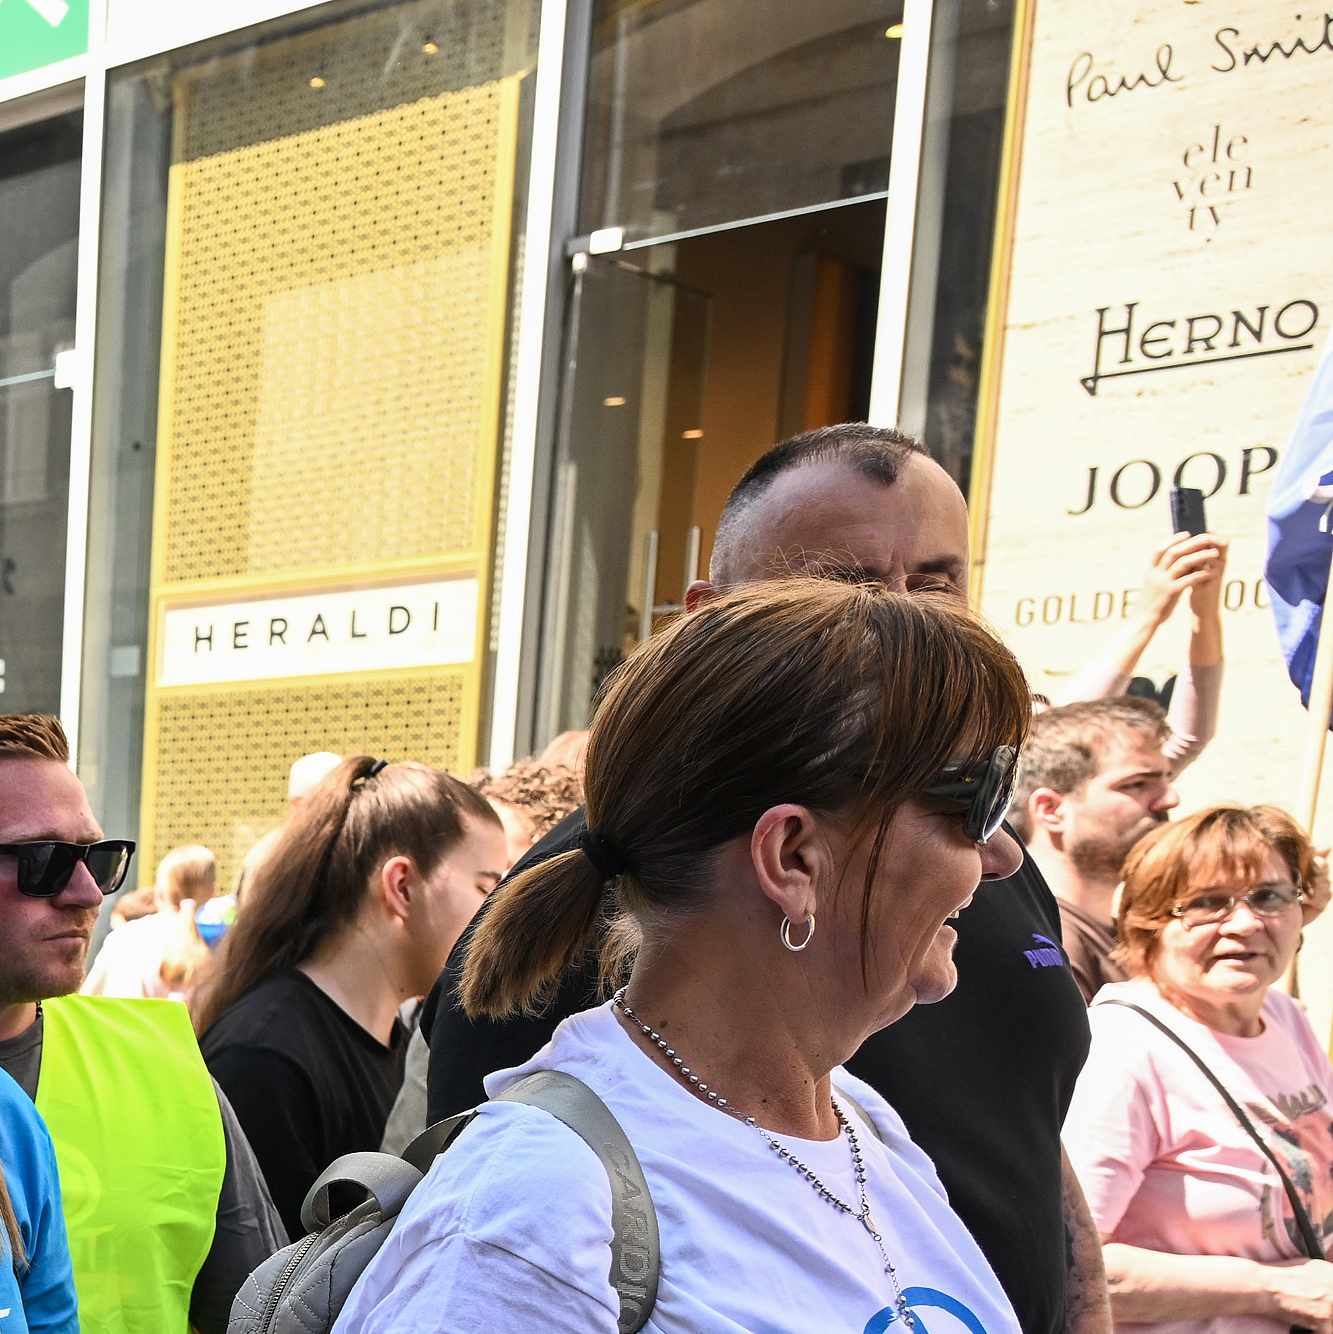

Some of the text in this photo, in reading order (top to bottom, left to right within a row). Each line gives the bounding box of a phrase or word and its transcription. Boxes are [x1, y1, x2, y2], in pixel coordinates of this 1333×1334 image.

[1066, 43, 1184, 108] Paul
[1065, 446, 1279, 516] JOOP
[193, 601, 440, 653] HERALDI
[1015, 588, 1141, 627] GOLDE
